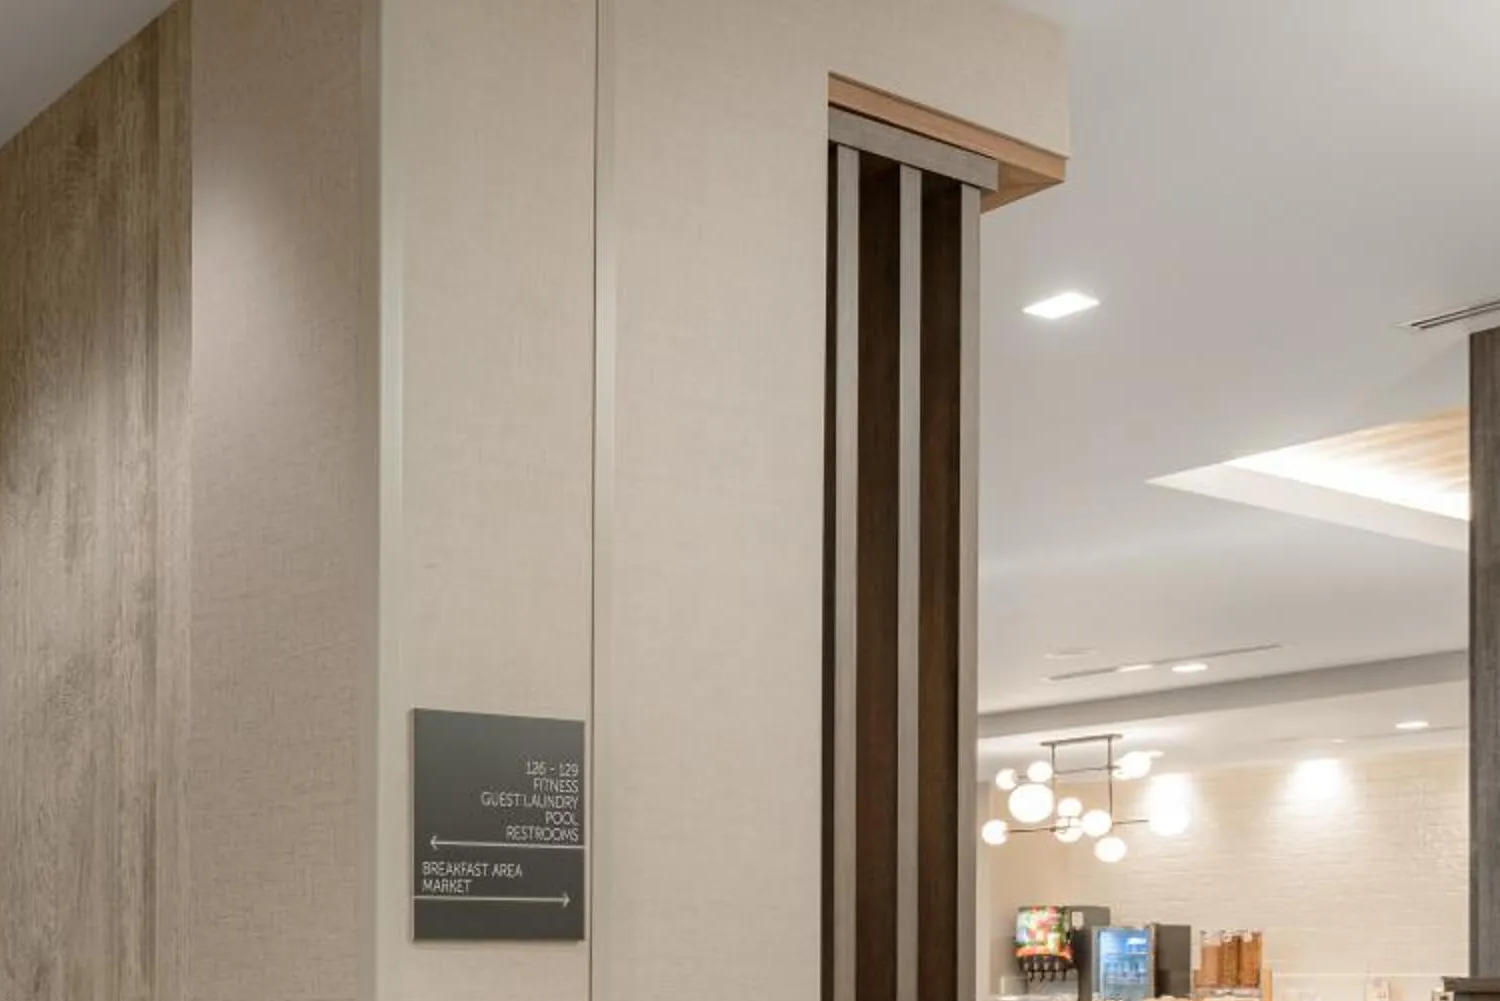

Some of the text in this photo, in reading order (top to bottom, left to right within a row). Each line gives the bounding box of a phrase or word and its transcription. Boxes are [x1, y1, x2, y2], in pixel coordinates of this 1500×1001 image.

[559, 763, 579, 777] 129
[533, 778, 579, 793] FITNESS
[481, 791, 579, 810] GUEST LAUNDRY
[546, 812, 579, 825] POOL
[506, 826, 579, 841] RESTROOMS
[422, 862, 523, 878] BREAKFAST AREA
[422, 879, 472, 893] MARKET
